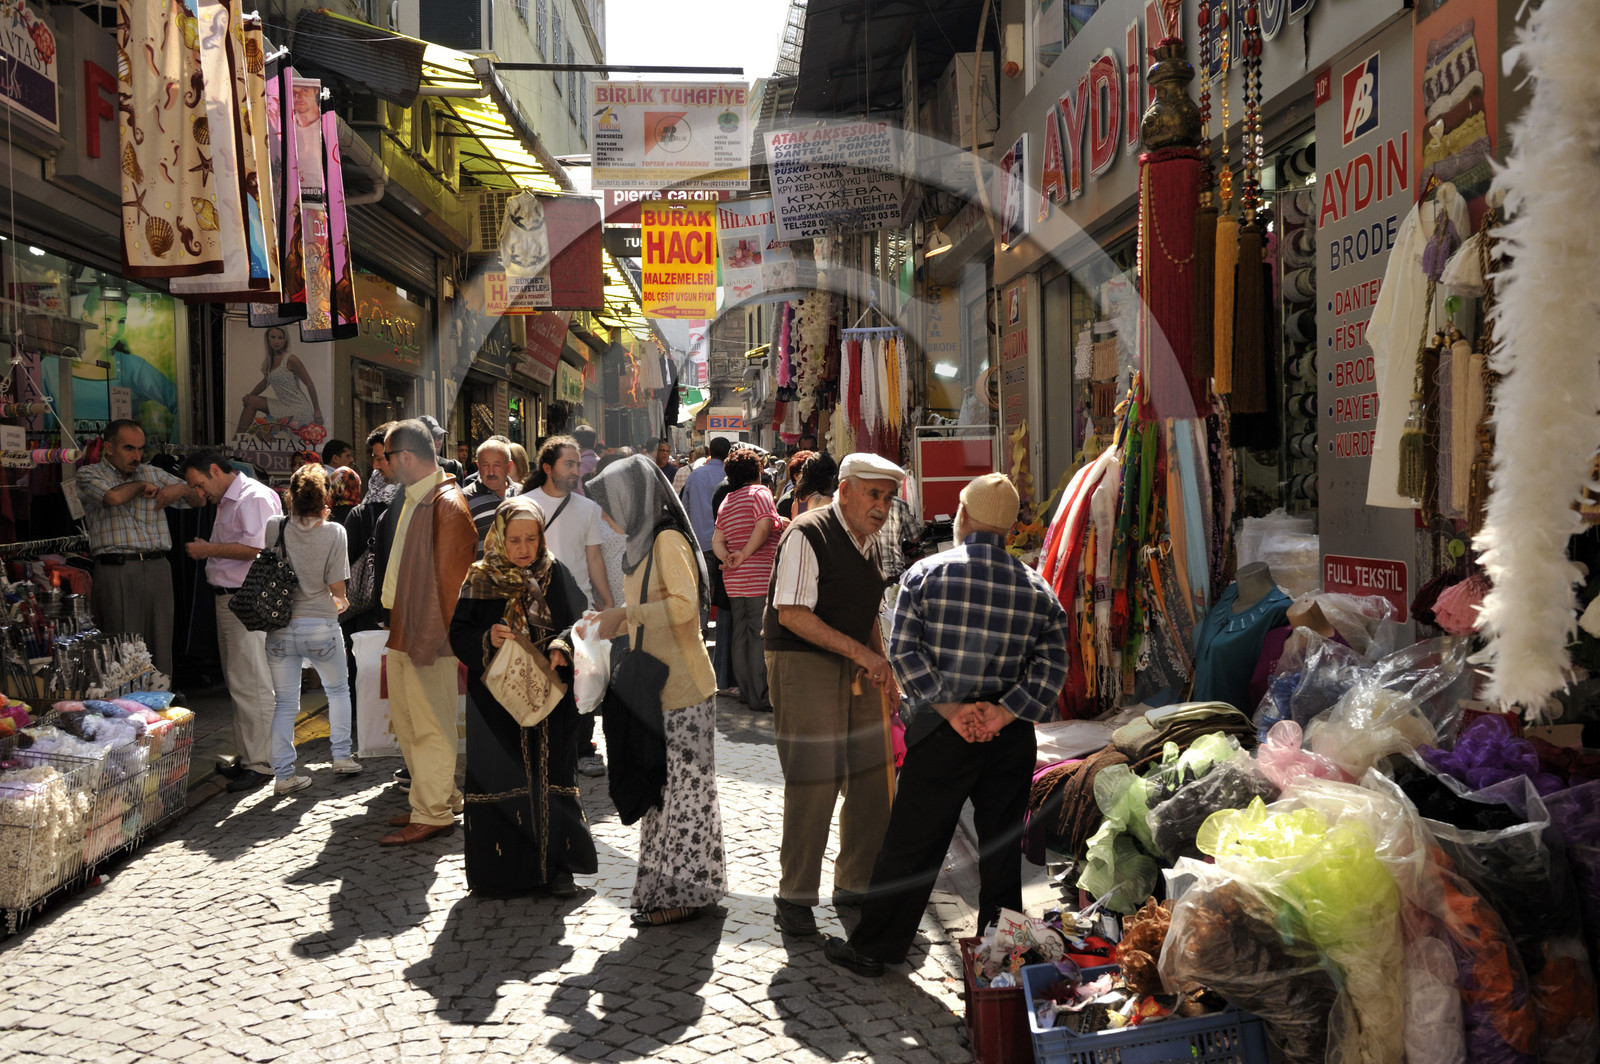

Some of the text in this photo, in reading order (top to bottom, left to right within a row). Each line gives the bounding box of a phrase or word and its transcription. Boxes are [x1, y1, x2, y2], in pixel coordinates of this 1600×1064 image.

[0, 27, 48, 75] NTASY
[596, 85, 746, 106] BİRLİK TUHAFİYE
[771, 123, 888, 146] ATAK AKSESUAR
[774, 140, 830, 151] KORDON
[775, 148, 823, 159] DANTEL
[838, 139, 890, 151] PONPON
[811, 153, 845, 162] KADİFE
[848, 148, 890, 158] KURDELA
[774, 165, 810, 175] PÜSKÜL
[777, 169, 844, 185] БАХРОМА
[1318, 129, 1408, 230] AYDIN
[614, 189, 720, 206] pierre cardin
[644, 210, 713, 227] BURAK
[783, 218, 817, 231] TEL:528
[878, 211, 889, 220] 03
[890, 210, 901, 218] 55
[623, 236, 643, 248] TU
[646, 231, 714, 265] HACI
[1329, 214, 1398, 273] BRODE
[515, 277, 545, 285] SÜNNET
[644, 270, 715, 286] MALZEMELERİ
[643, 289, 716, 304] BOL ÇEŞİT UYGUN FİYAT
[1334, 391, 1379, 424] PAYET
[236, 432, 321, 453] FANTASY
[1327, 562, 1403, 592] FULL TEKSTİL
